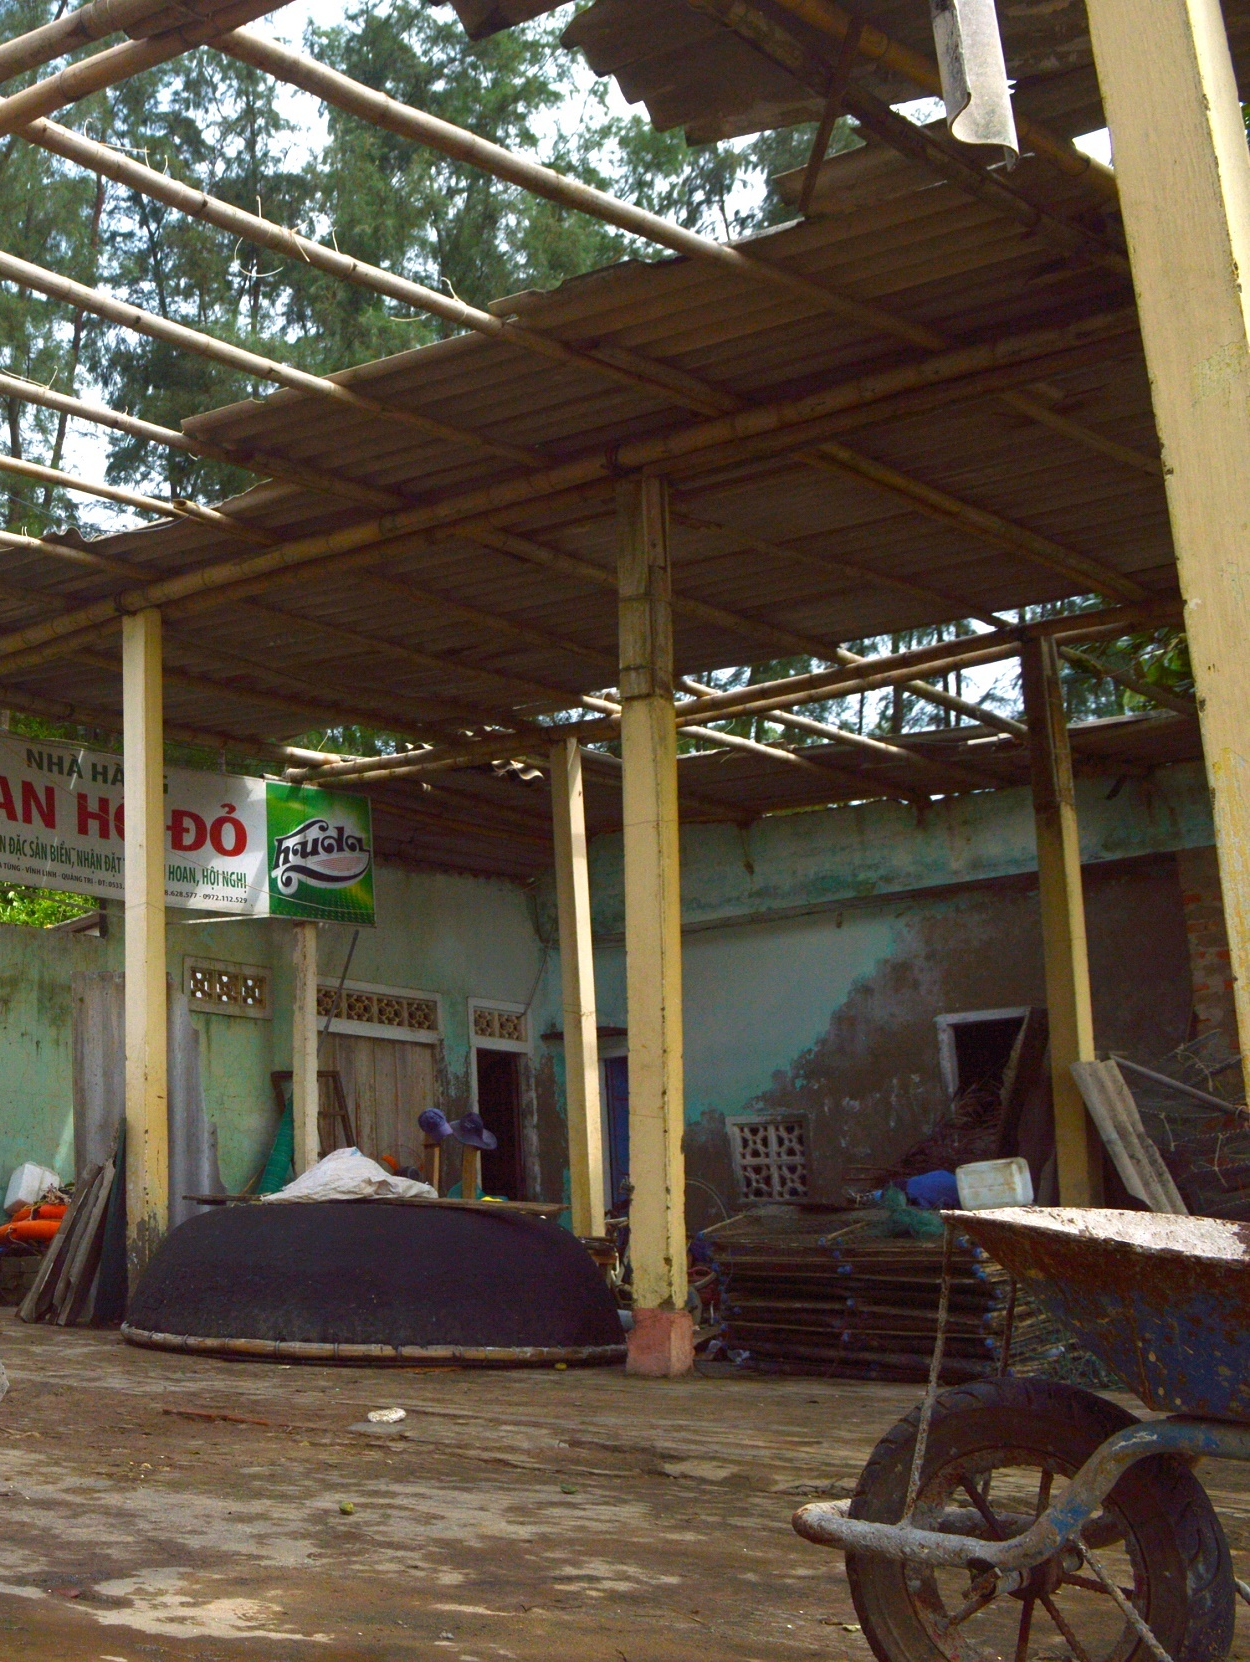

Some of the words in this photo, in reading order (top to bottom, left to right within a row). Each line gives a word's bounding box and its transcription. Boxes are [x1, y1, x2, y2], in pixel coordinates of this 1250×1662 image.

[25, 748, 84, 780] NHÀ
[166, 803, 248, 858] ĐỎ
[8, 834, 28, 861] ĐẶC
[29, 836, 48, 861] SẢN
[76, 848, 103, 874] NHẬN
[168, 864, 200, 887] HOAN,
[202, 866, 220, 891] HỘI
[222, 870, 247, 894] NGHỊ
[42, 868, 57, 879] LINH
[202, 893, 248, 904] 0972.112.529
